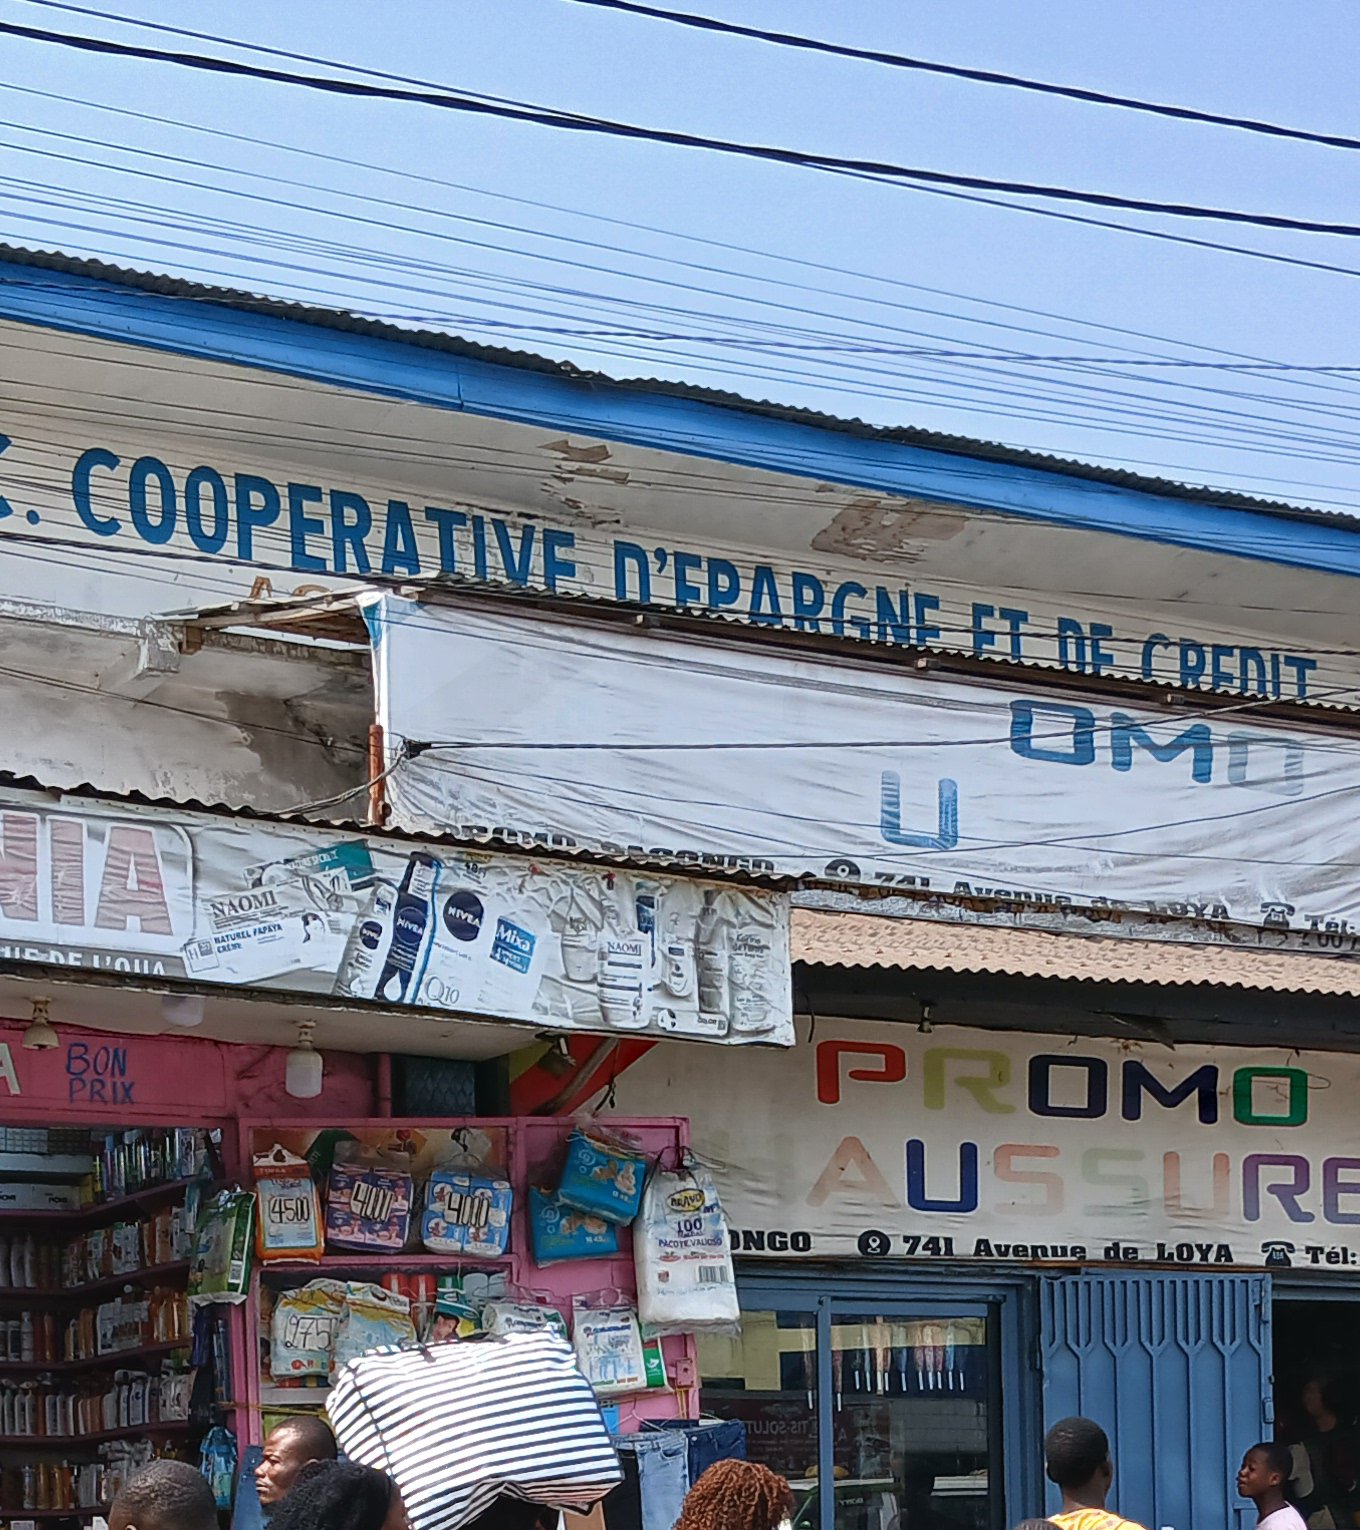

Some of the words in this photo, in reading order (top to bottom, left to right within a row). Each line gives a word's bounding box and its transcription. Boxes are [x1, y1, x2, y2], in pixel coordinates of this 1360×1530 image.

[72, 447, 577, 592] COOPERATIVE
[972, 602, 1028, 663] ET
[1058, 616, 1114, 674] DE
[1141, 632, 1317, 698] CREDIT
[210, 890, 278, 918] NAOMI
[448, 905, 481, 927] NIVEA
[397, 915, 424, 935] NIVEA
[495, 924, 530, 950] Mixa
[66, 1043, 127, 1078] BON
[68, 1075, 135, 1104] PRIX
[815, 1040, 1309, 1127] PROMO
[671, 1193, 702, 1208] BRAVO
[677, 1218, 703, 1233] 100
[901, 1235, 955, 1257] 741
[973, 1240, 1087, 1261] Avenue
[1103, 1239, 1140, 1262] de
[1155, 1241, 1234, 1264] LOYA
[1305, 1244, 1360, 1268] Tél:
